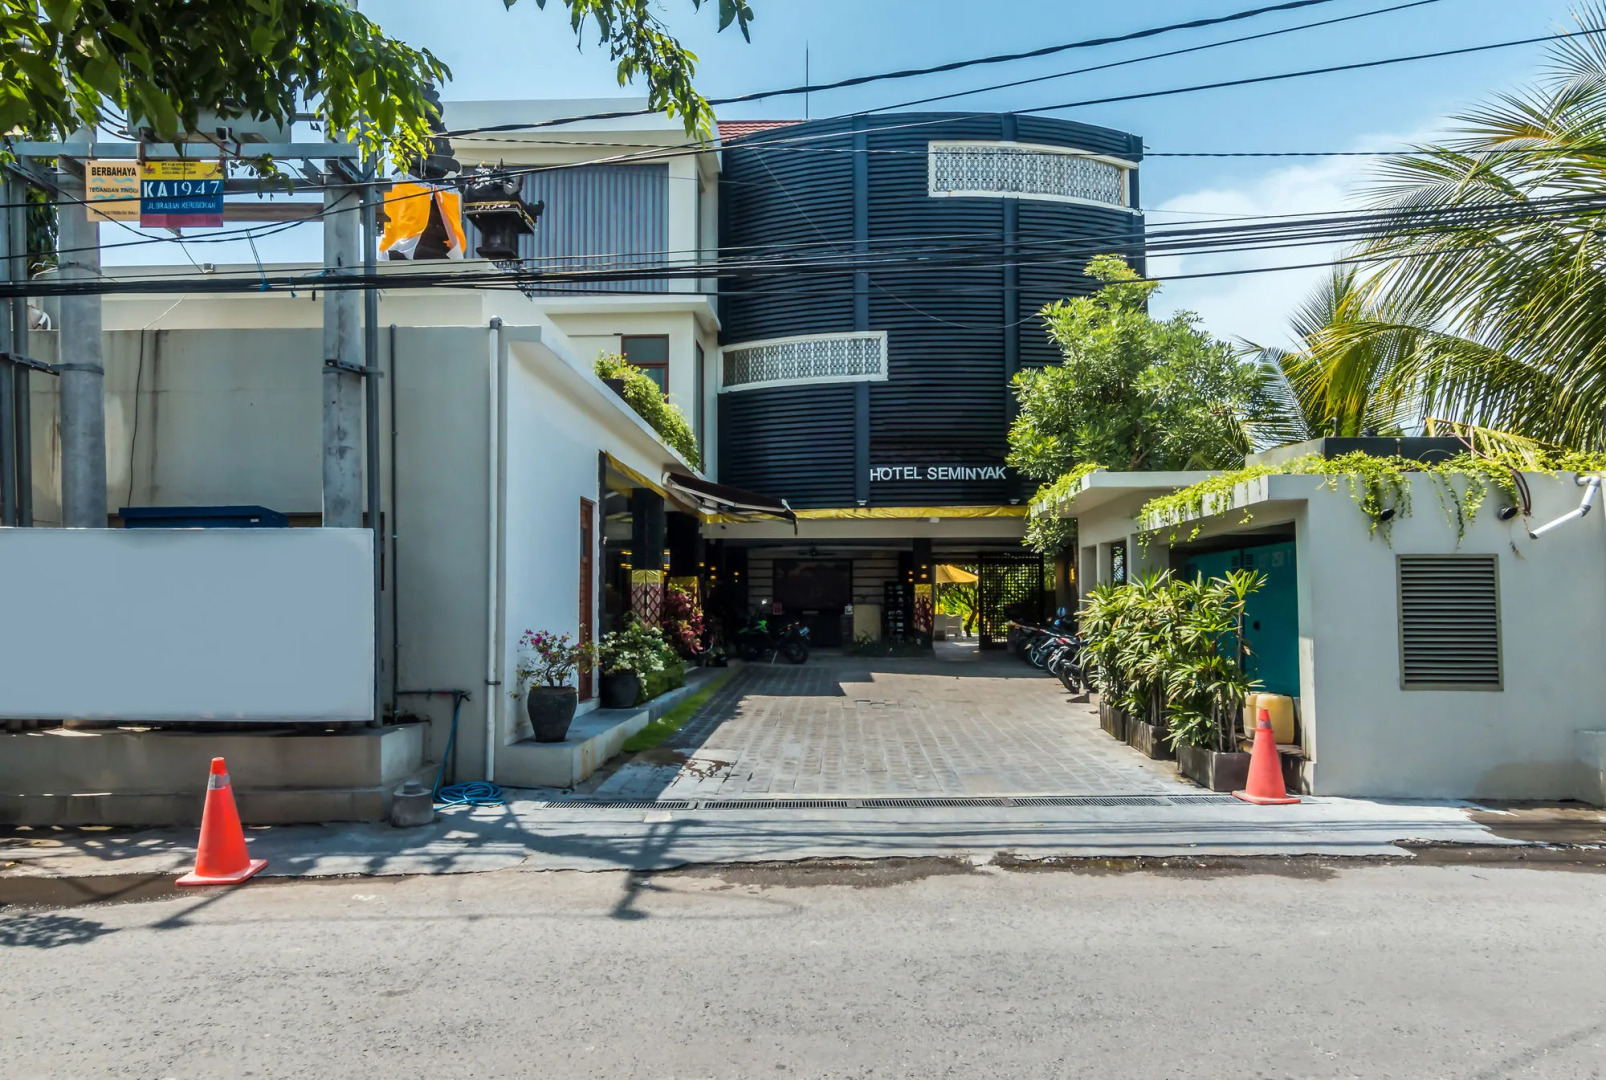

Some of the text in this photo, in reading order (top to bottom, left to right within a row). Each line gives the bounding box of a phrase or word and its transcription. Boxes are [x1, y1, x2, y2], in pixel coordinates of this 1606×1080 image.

[91, 167, 137, 177] BERBAHAYA
[174, 180, 220, 197] 1947
[869, 466, 1007, 481] HOTEL SEMINYAK
